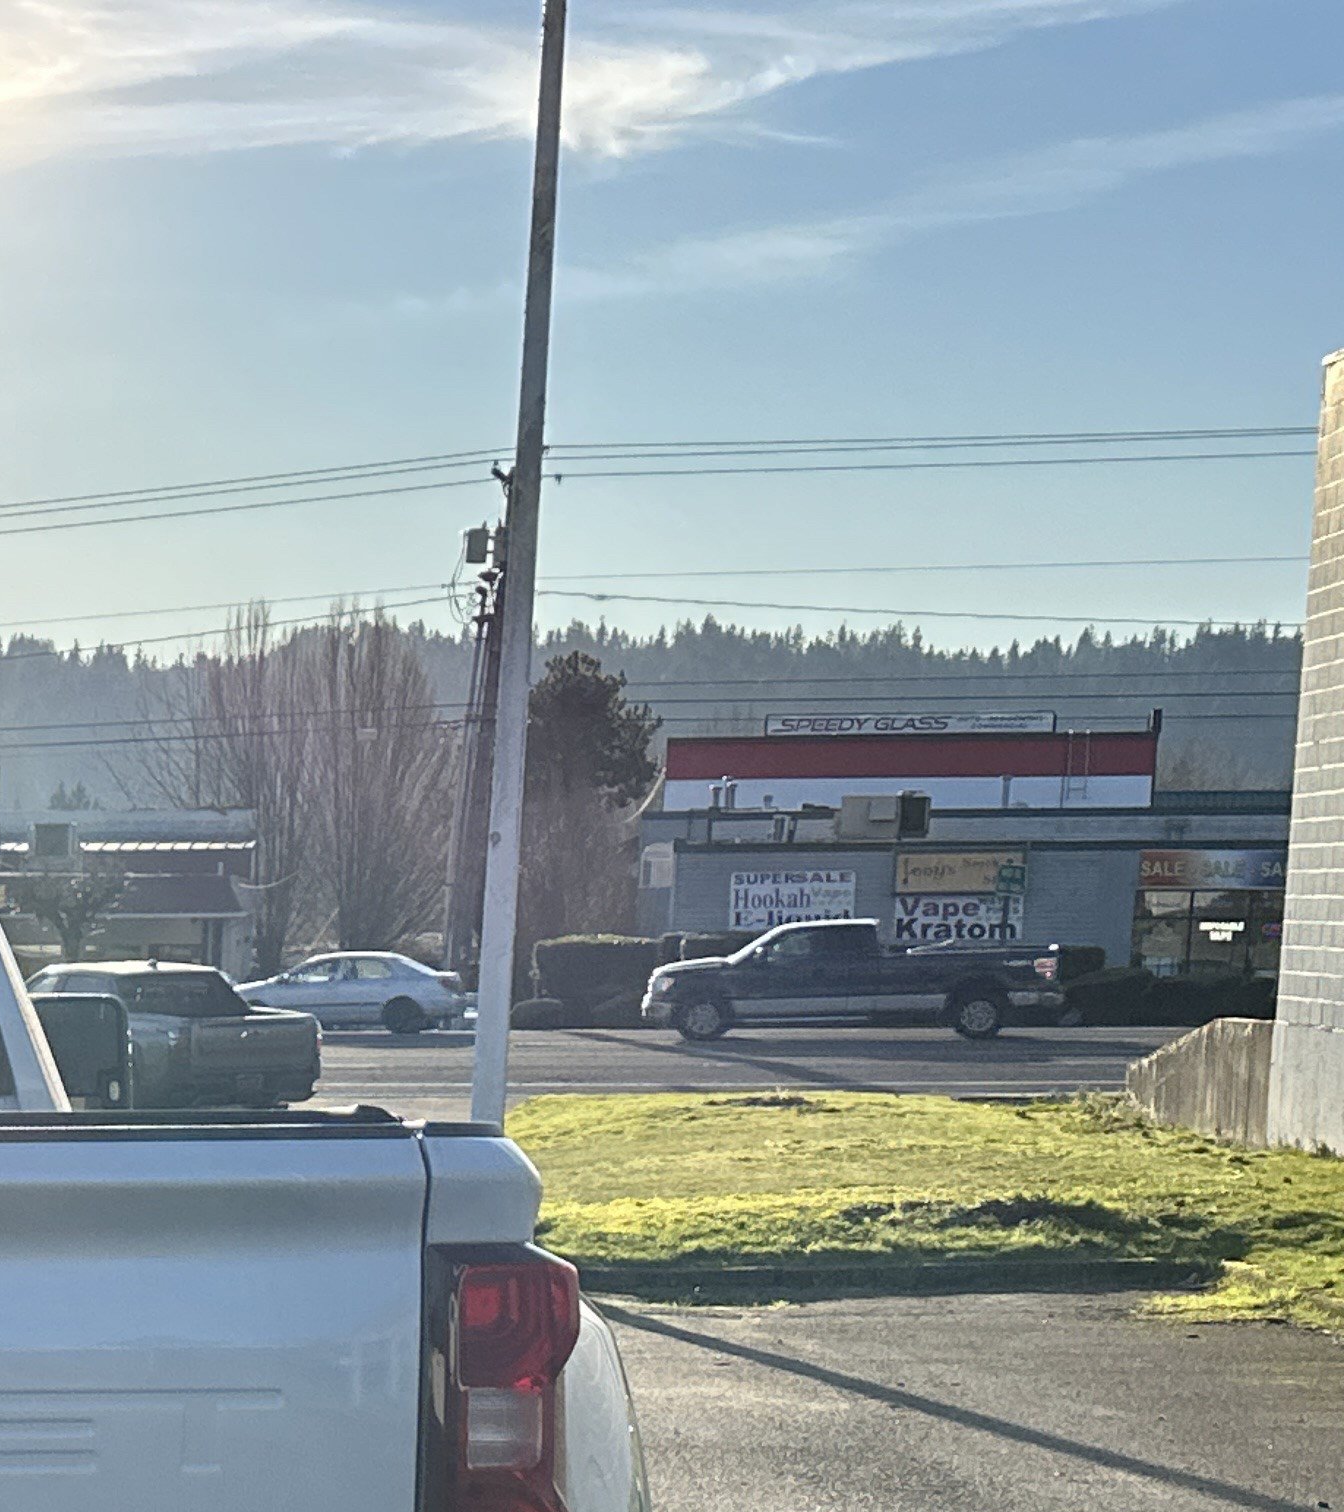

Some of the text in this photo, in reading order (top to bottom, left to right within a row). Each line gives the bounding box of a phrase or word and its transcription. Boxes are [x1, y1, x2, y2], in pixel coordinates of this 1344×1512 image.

[771, 716, 952, 732] SPEEDY GLASS
[734, 871, 852, 884] SUPERSALE
[1140, 861, 1185, 877] SALE
[734, 887, 811, 909] Hookah
[899, 897, 980, 921] Vape
[896, 917, 1017, 939] Kratom
